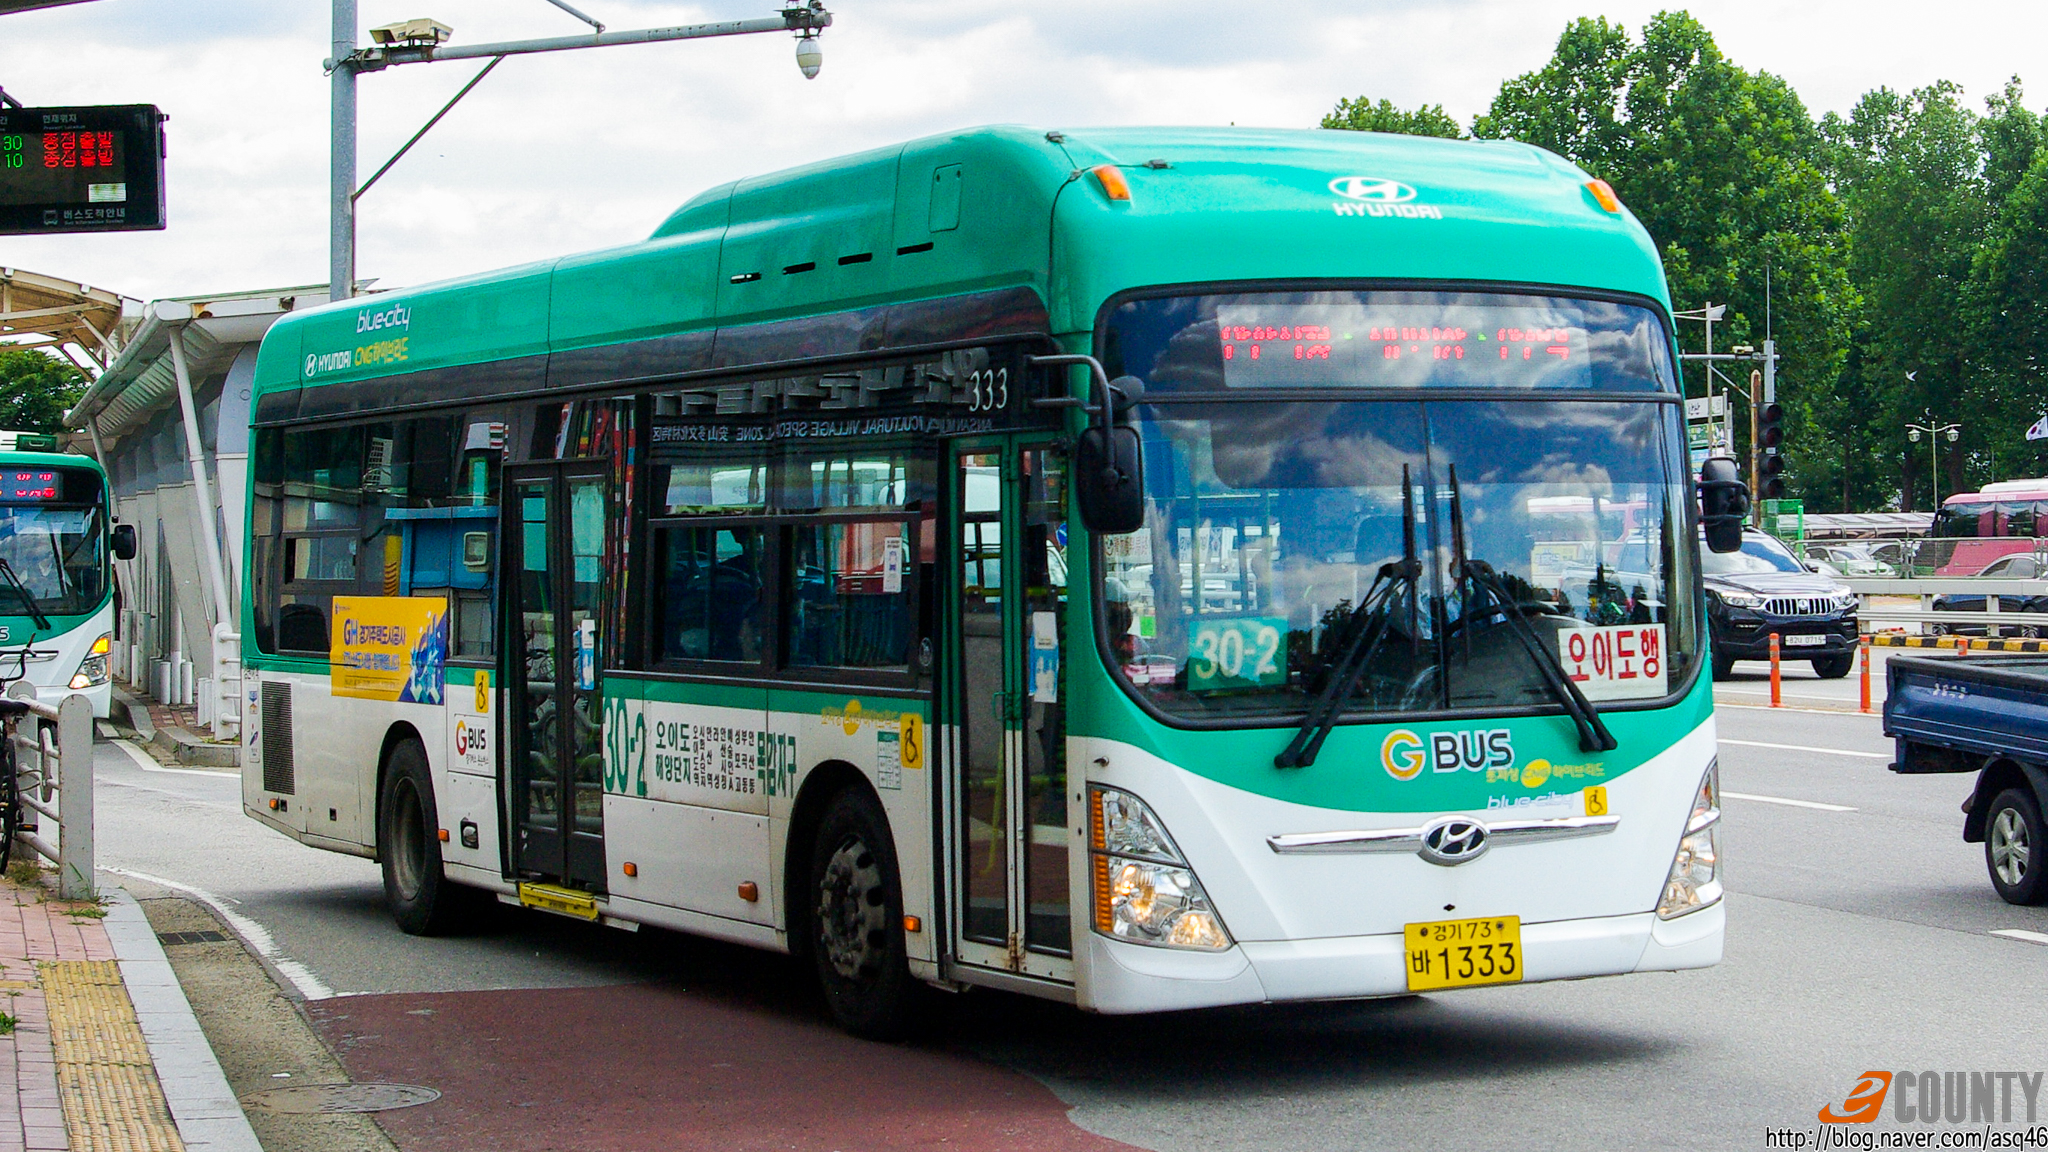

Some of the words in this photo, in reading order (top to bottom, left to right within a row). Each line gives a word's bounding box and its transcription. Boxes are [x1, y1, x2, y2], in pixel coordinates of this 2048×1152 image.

[3, 135, 23, 151] 30
[5, 153, 23, 169] 10
[63, 208, 126, 220] 버스도착안내
[1332, 202, 1443, 220] HYUNDAI
[318, 350, 352, 372] HYUNDAI
[969, 367, 1008, 412] 333
[343, 618, 359, 646] GH
[1195, 625, 1280, 679] 30-2
[1568, 628, 1660, 682] 오이도행
[456, 720, 467, 756] G
[468, 728, 486, 750] BUS
[602, 697, 648, 796] 30-2
[656, 720, 691, 753] 오이도
[656, 754, 691, 785] 해양단지
[1380, 729, 1426, 781] G
[1430, 728, 1515, 773] BUS
[1433, 924, 1462, 941] 경기
[1466, 922, 1491, 939] 73
[1412, 949, 1431, 974] 바
[1438, 942, 1516, 980] 1333
